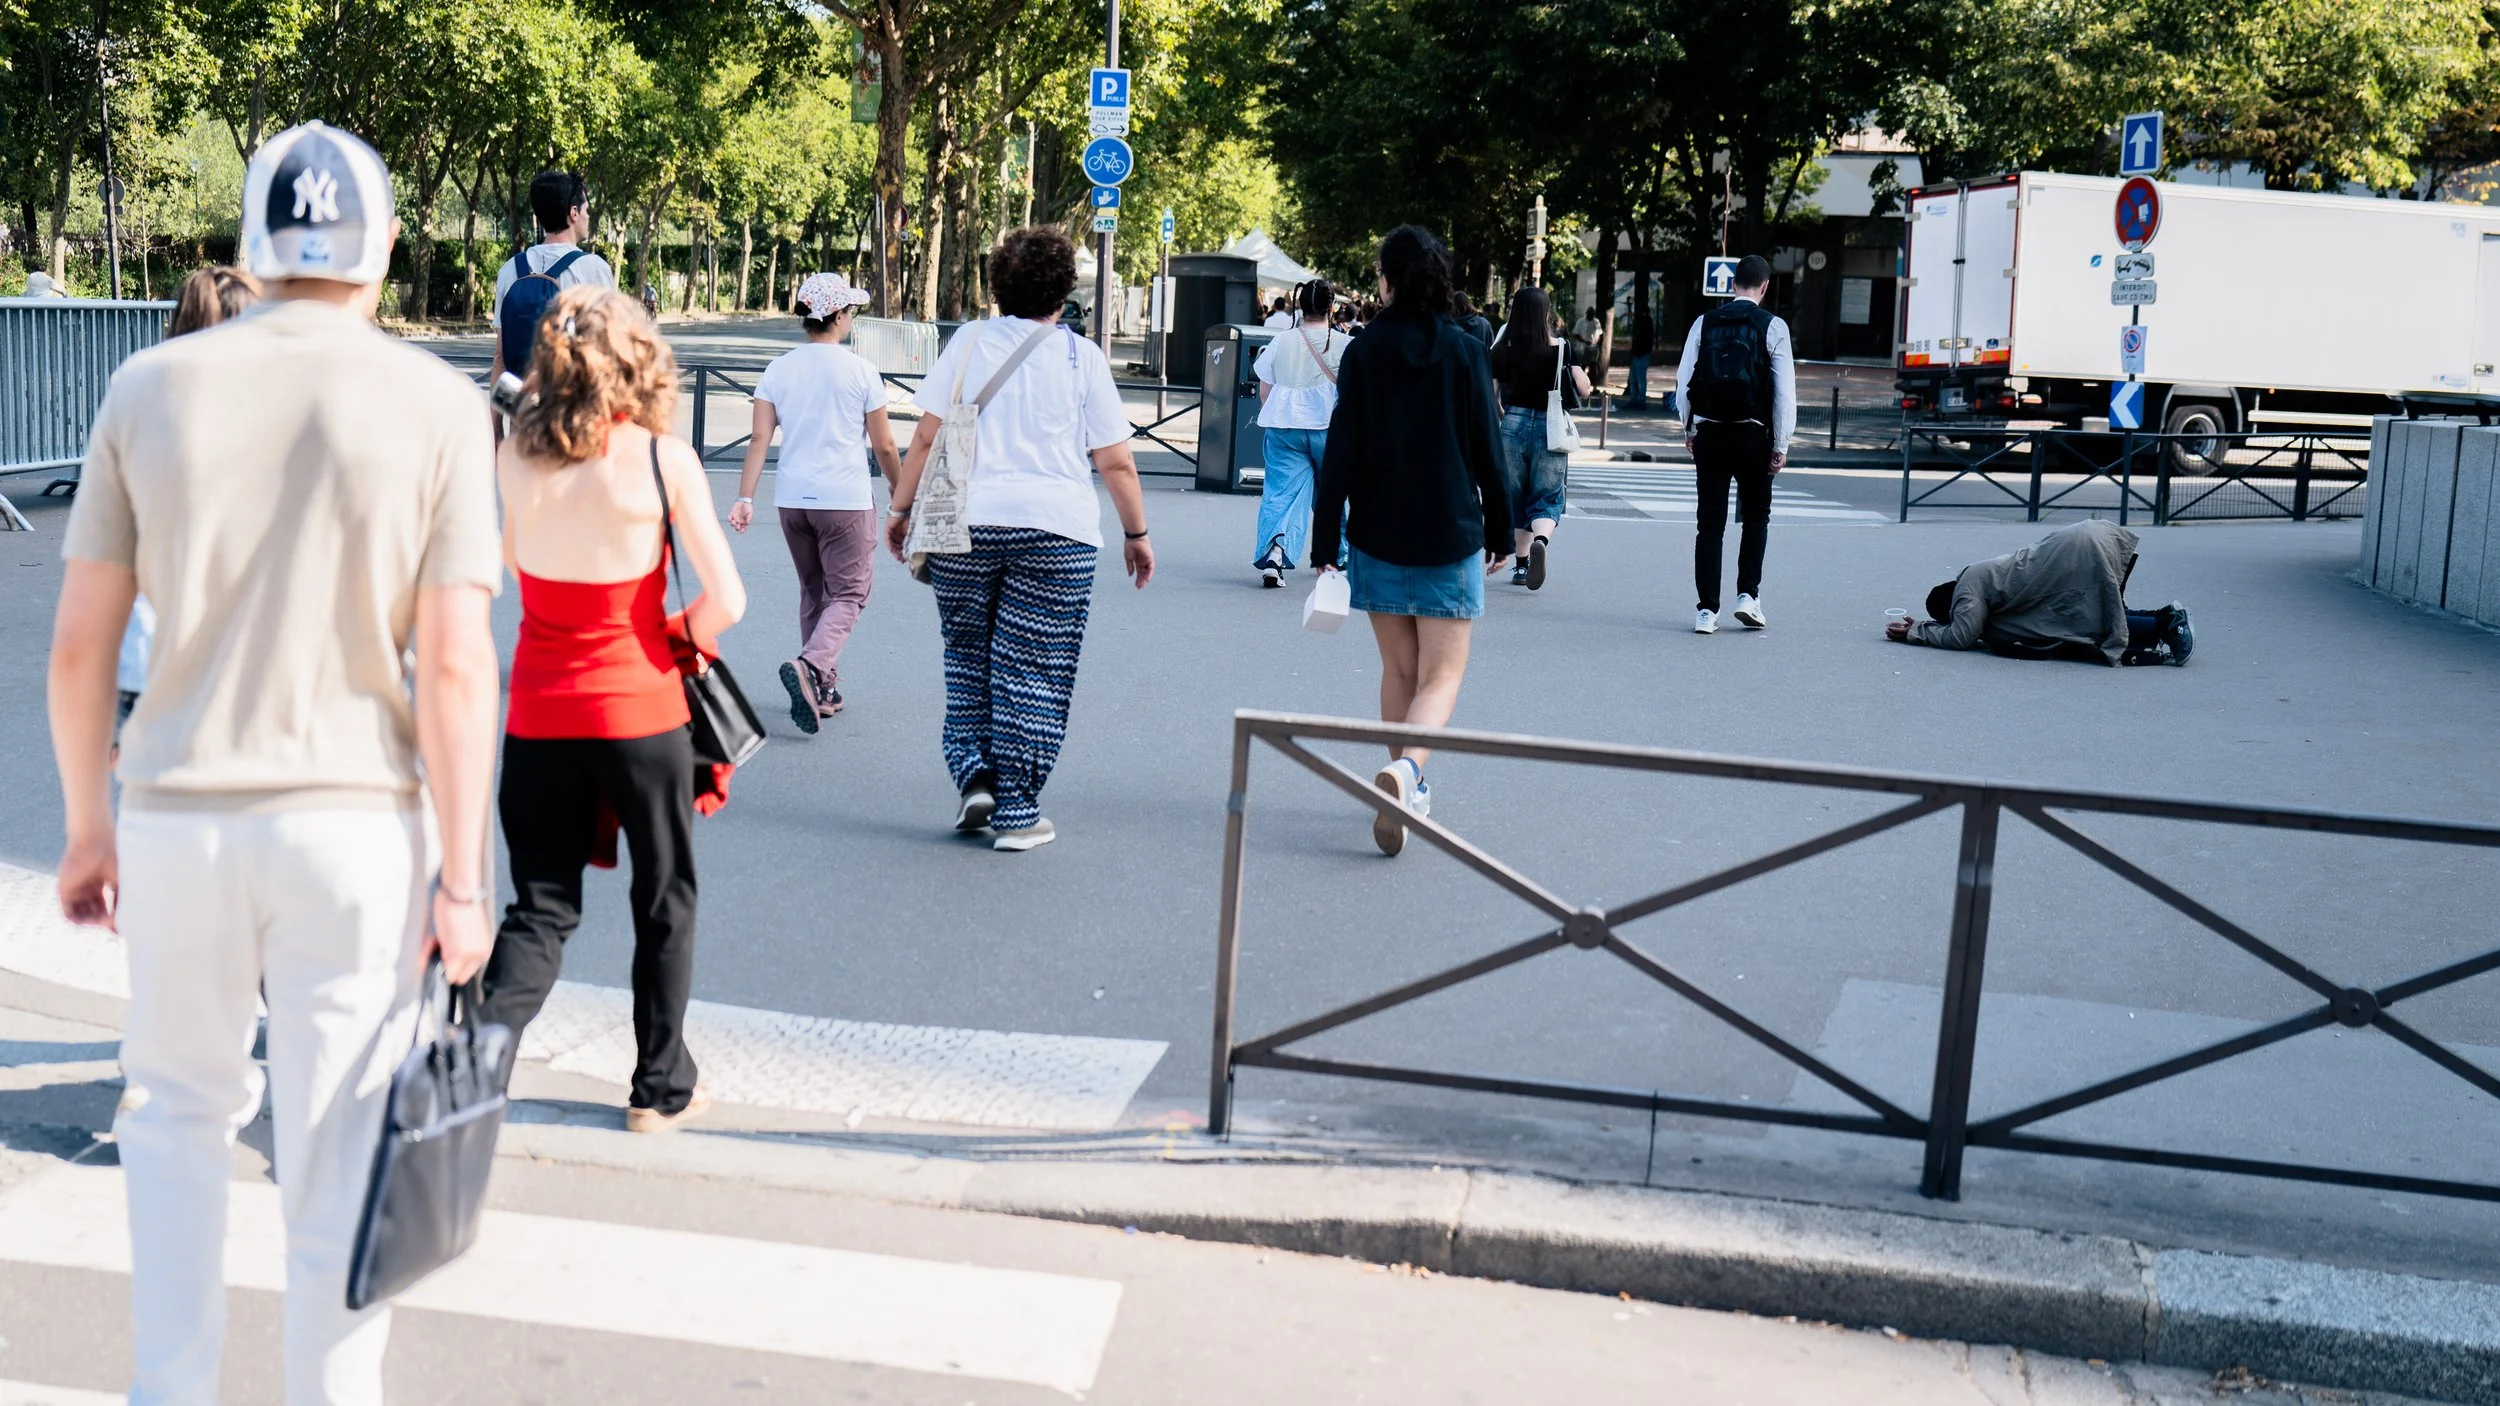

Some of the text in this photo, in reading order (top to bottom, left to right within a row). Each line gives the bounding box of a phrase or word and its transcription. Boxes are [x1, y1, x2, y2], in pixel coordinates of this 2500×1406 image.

[1101, 77, 1118, 102] P
[292, 166, 340, 223] NY
[1811, 255, 1824, 265] 101
